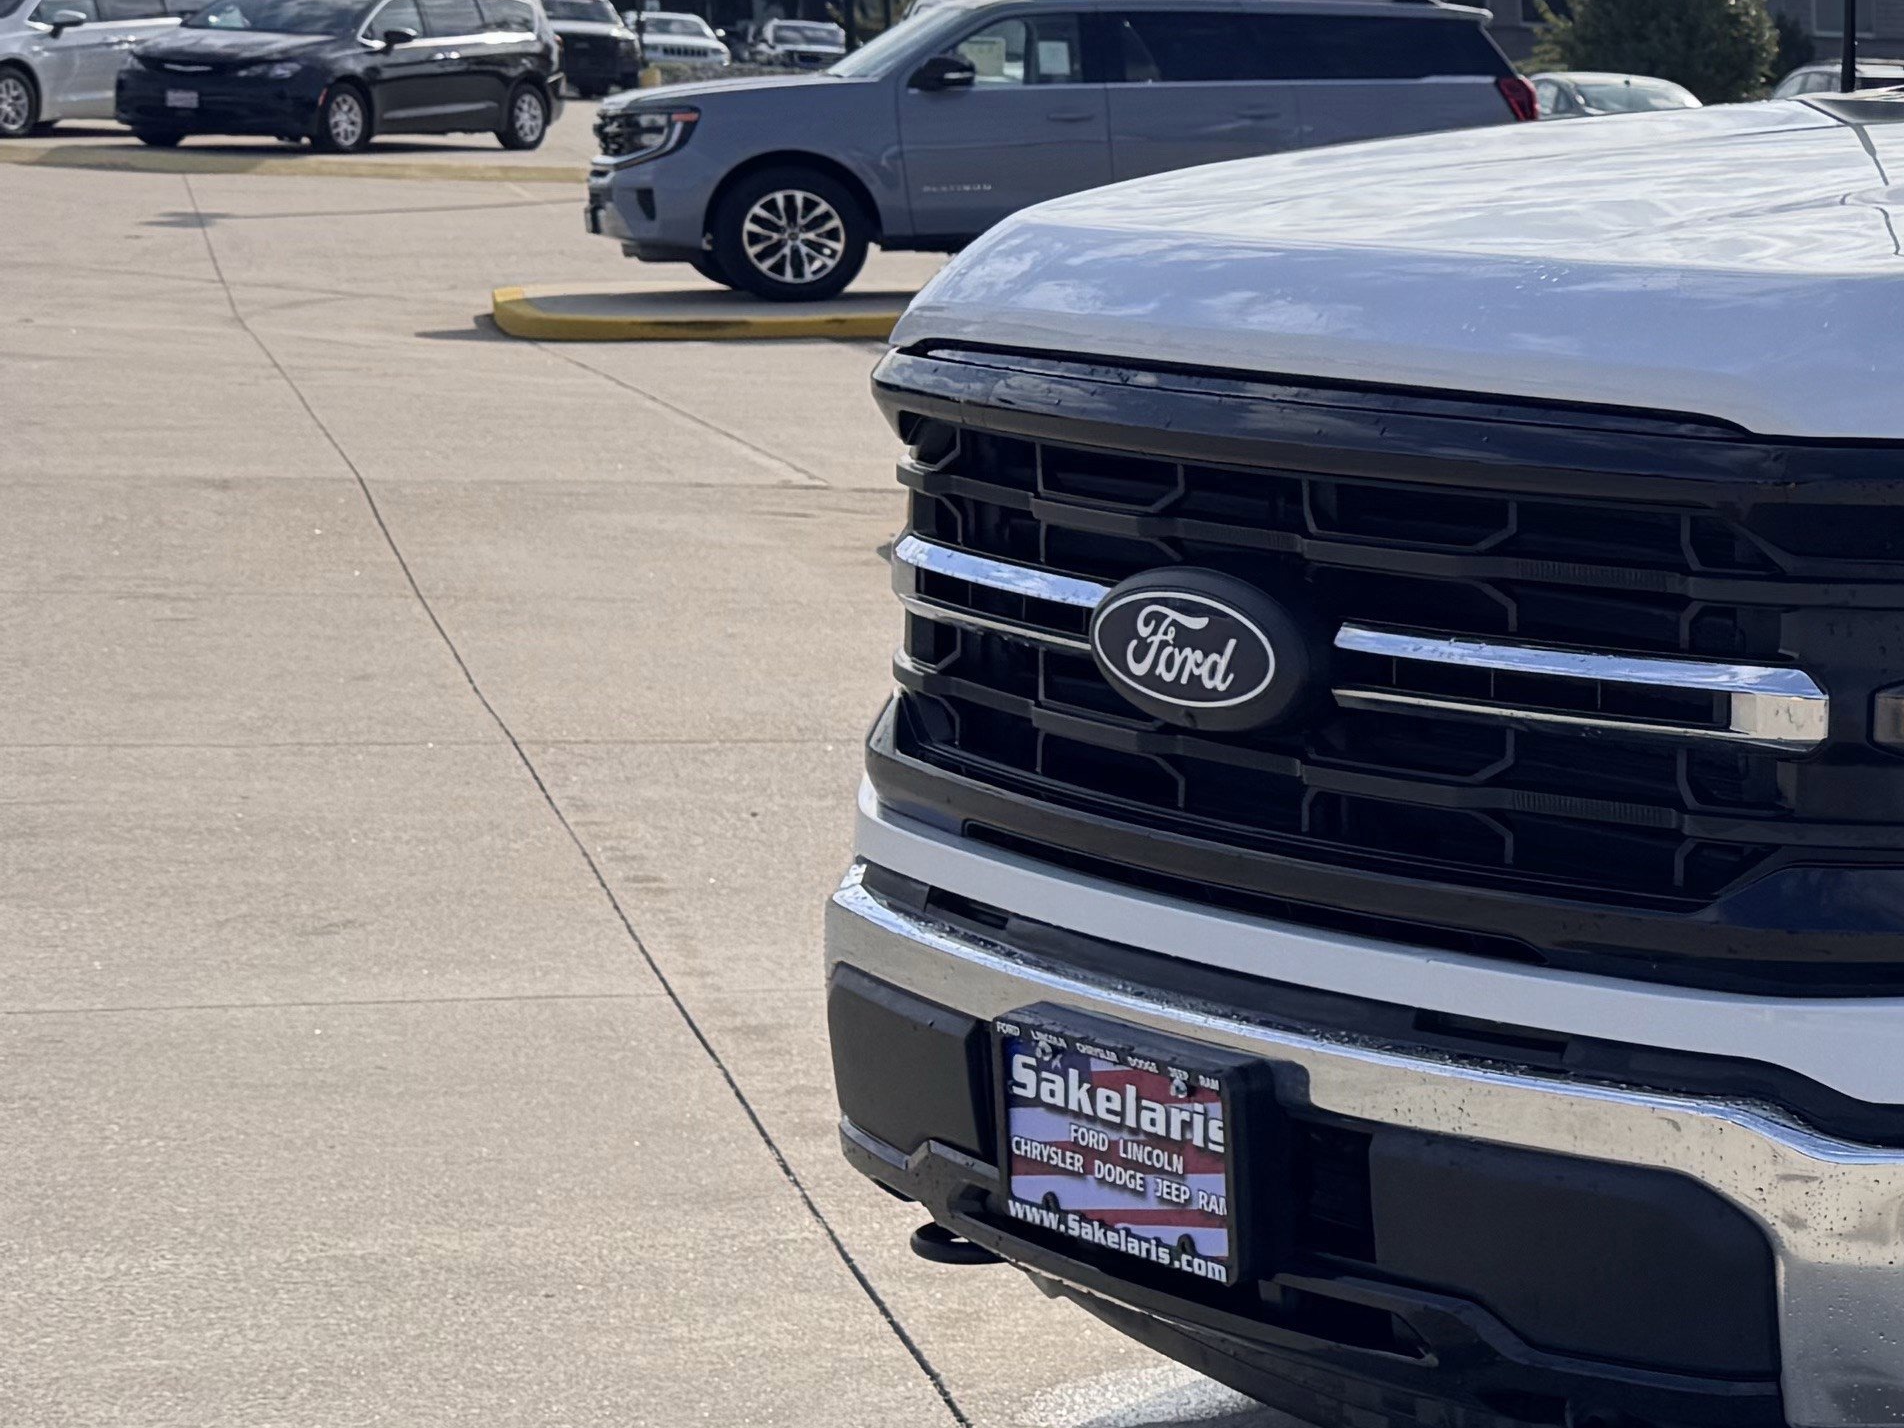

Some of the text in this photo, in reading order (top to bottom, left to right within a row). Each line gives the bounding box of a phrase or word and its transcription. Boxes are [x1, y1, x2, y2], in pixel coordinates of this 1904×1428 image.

[1126, 604, 1238, 692] Ford
[1012, 1053, 1225, 1153] Sakelaris
[1012, 1136, 1085, 1174] CHRYSLER
[1094, 1159, 1145, 1192] DODGE
[1156, 1178, 1190, 1204] JEEP
[1070, 1123, 1184, 1175] FORD LINCOLN
[1008, 1199, 1228, 1283] www.Sakelaris.com
